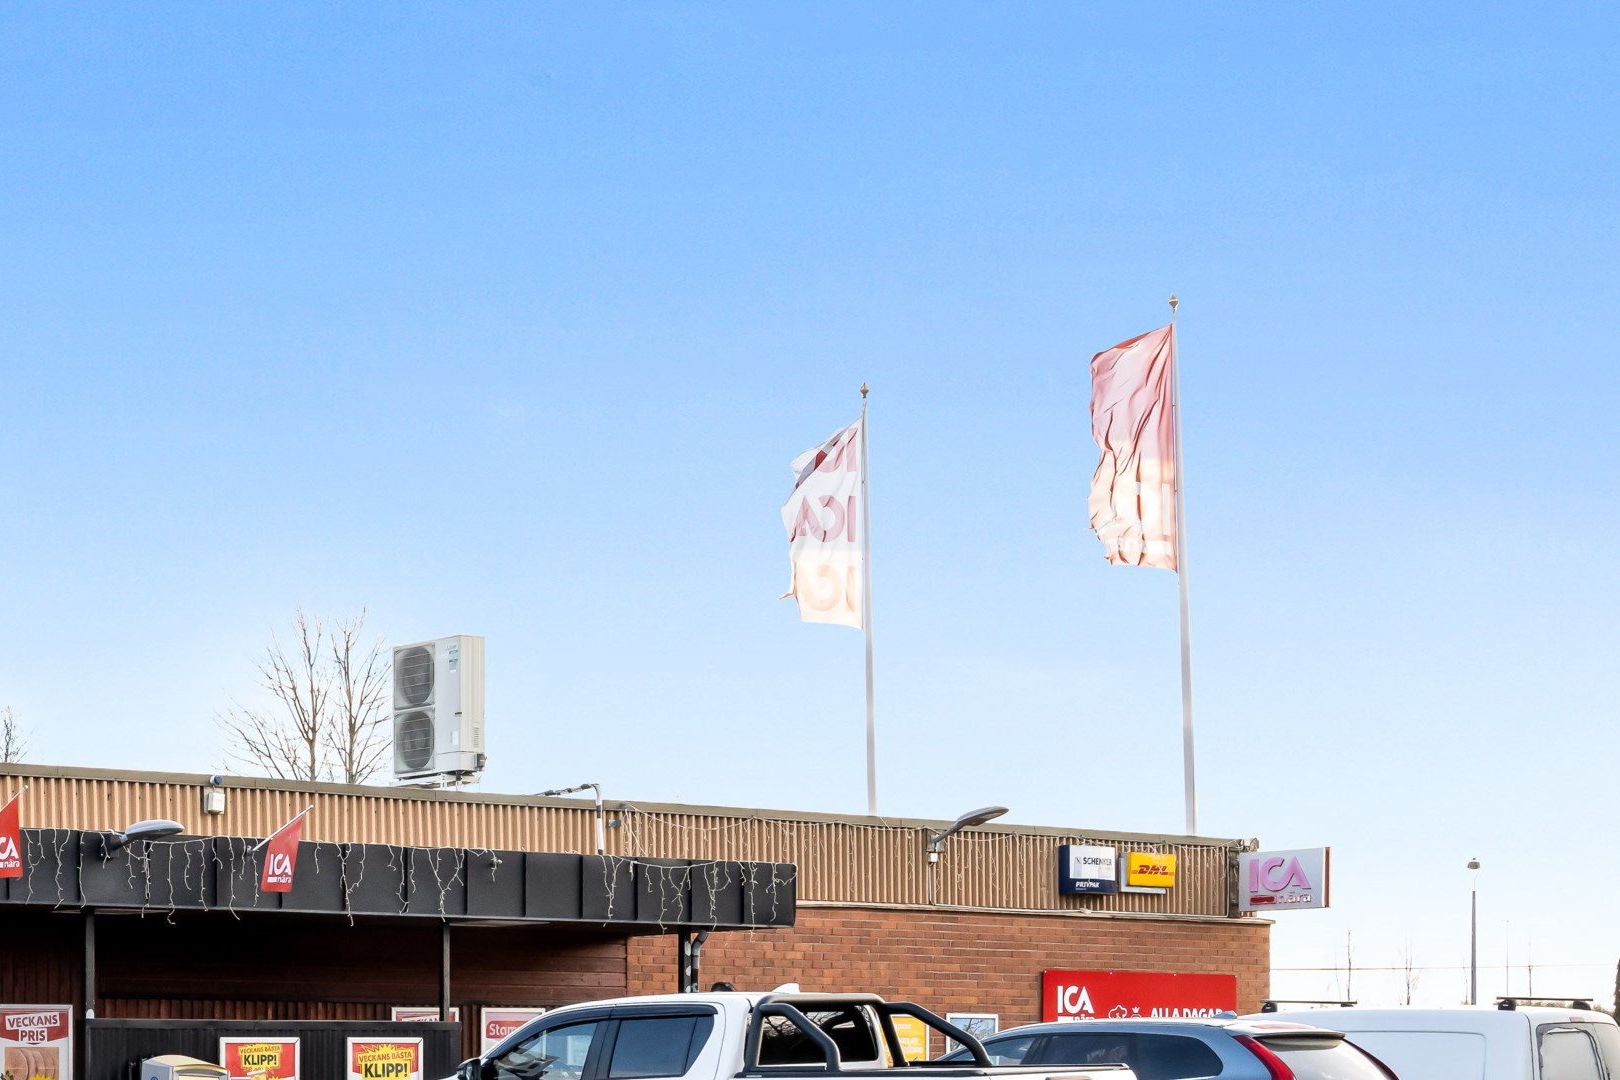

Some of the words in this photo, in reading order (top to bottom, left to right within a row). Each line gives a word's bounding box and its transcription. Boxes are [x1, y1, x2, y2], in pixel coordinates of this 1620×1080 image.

[268, 853, 291, 875] ICA
[1138, 865, 1168, 875] DHL
[1250, 856, 1311, 892] ICA
[1057, 986, 1094, 1014] ICA
[8, 1015, 58, 1028] VECKANS
[21, 1030, 45, 1041] PRIS
[244, 1055, 276, 1065] KLIPP!
[359, 1054, 390, 1062] VECKANS
[392, 1051, 412, 1059] BÄSTA
[365, 1063, 407, 1077] KLIPP!
